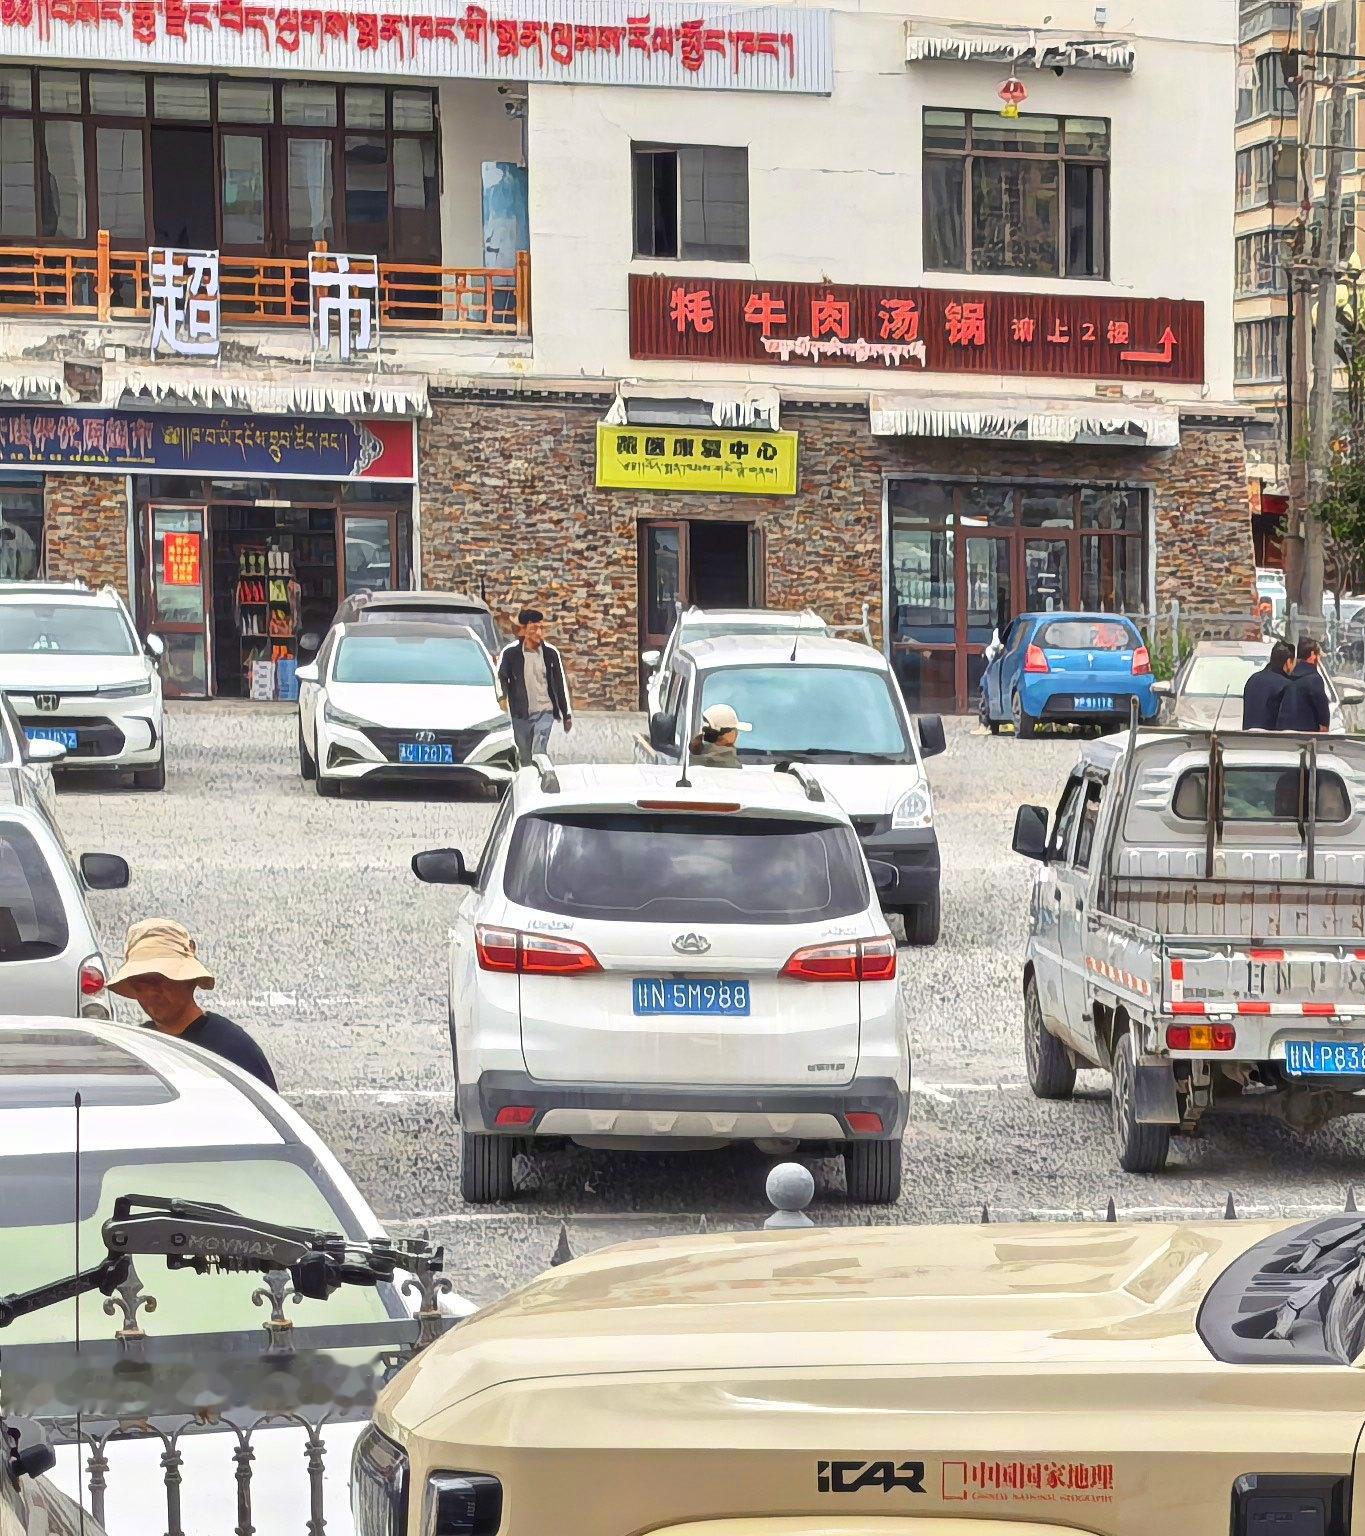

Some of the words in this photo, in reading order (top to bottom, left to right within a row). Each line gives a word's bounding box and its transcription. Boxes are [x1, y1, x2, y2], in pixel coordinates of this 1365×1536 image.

[151, 249, 379, 364] 超市
[670, 287, 986, 346] 牦牛肉汤锅
[972, 1461, 1113, 1490] 中国国家地理
